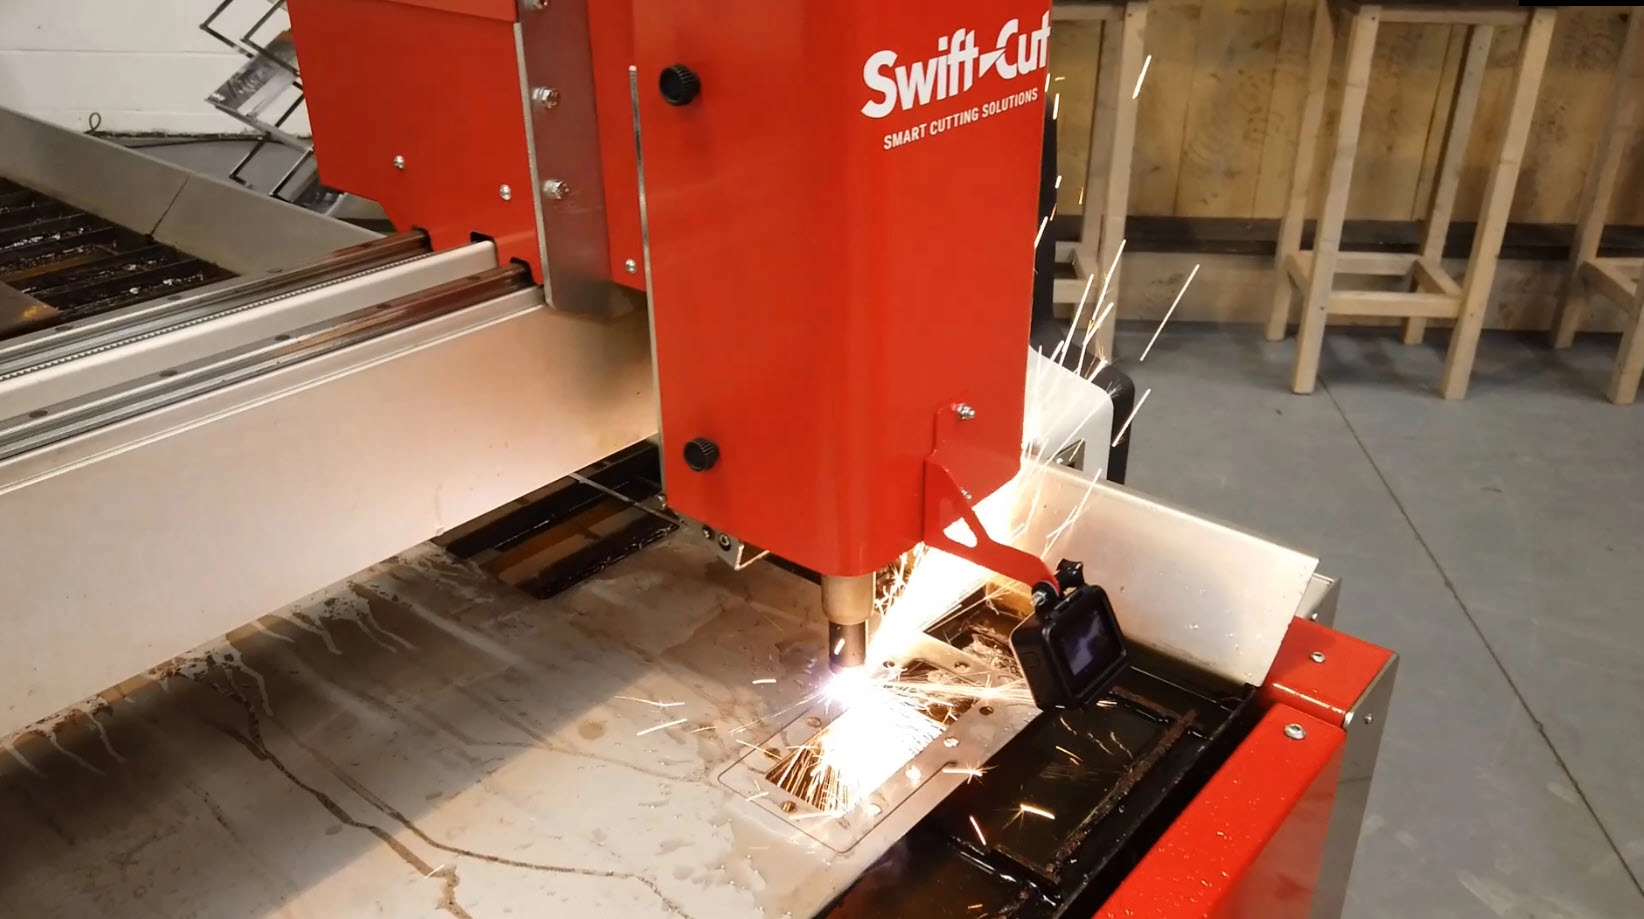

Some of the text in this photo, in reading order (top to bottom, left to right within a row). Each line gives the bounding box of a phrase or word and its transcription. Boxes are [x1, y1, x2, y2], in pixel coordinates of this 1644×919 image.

[883, 87, 1038, 150] SMART CUTTING SOLUTIONS
